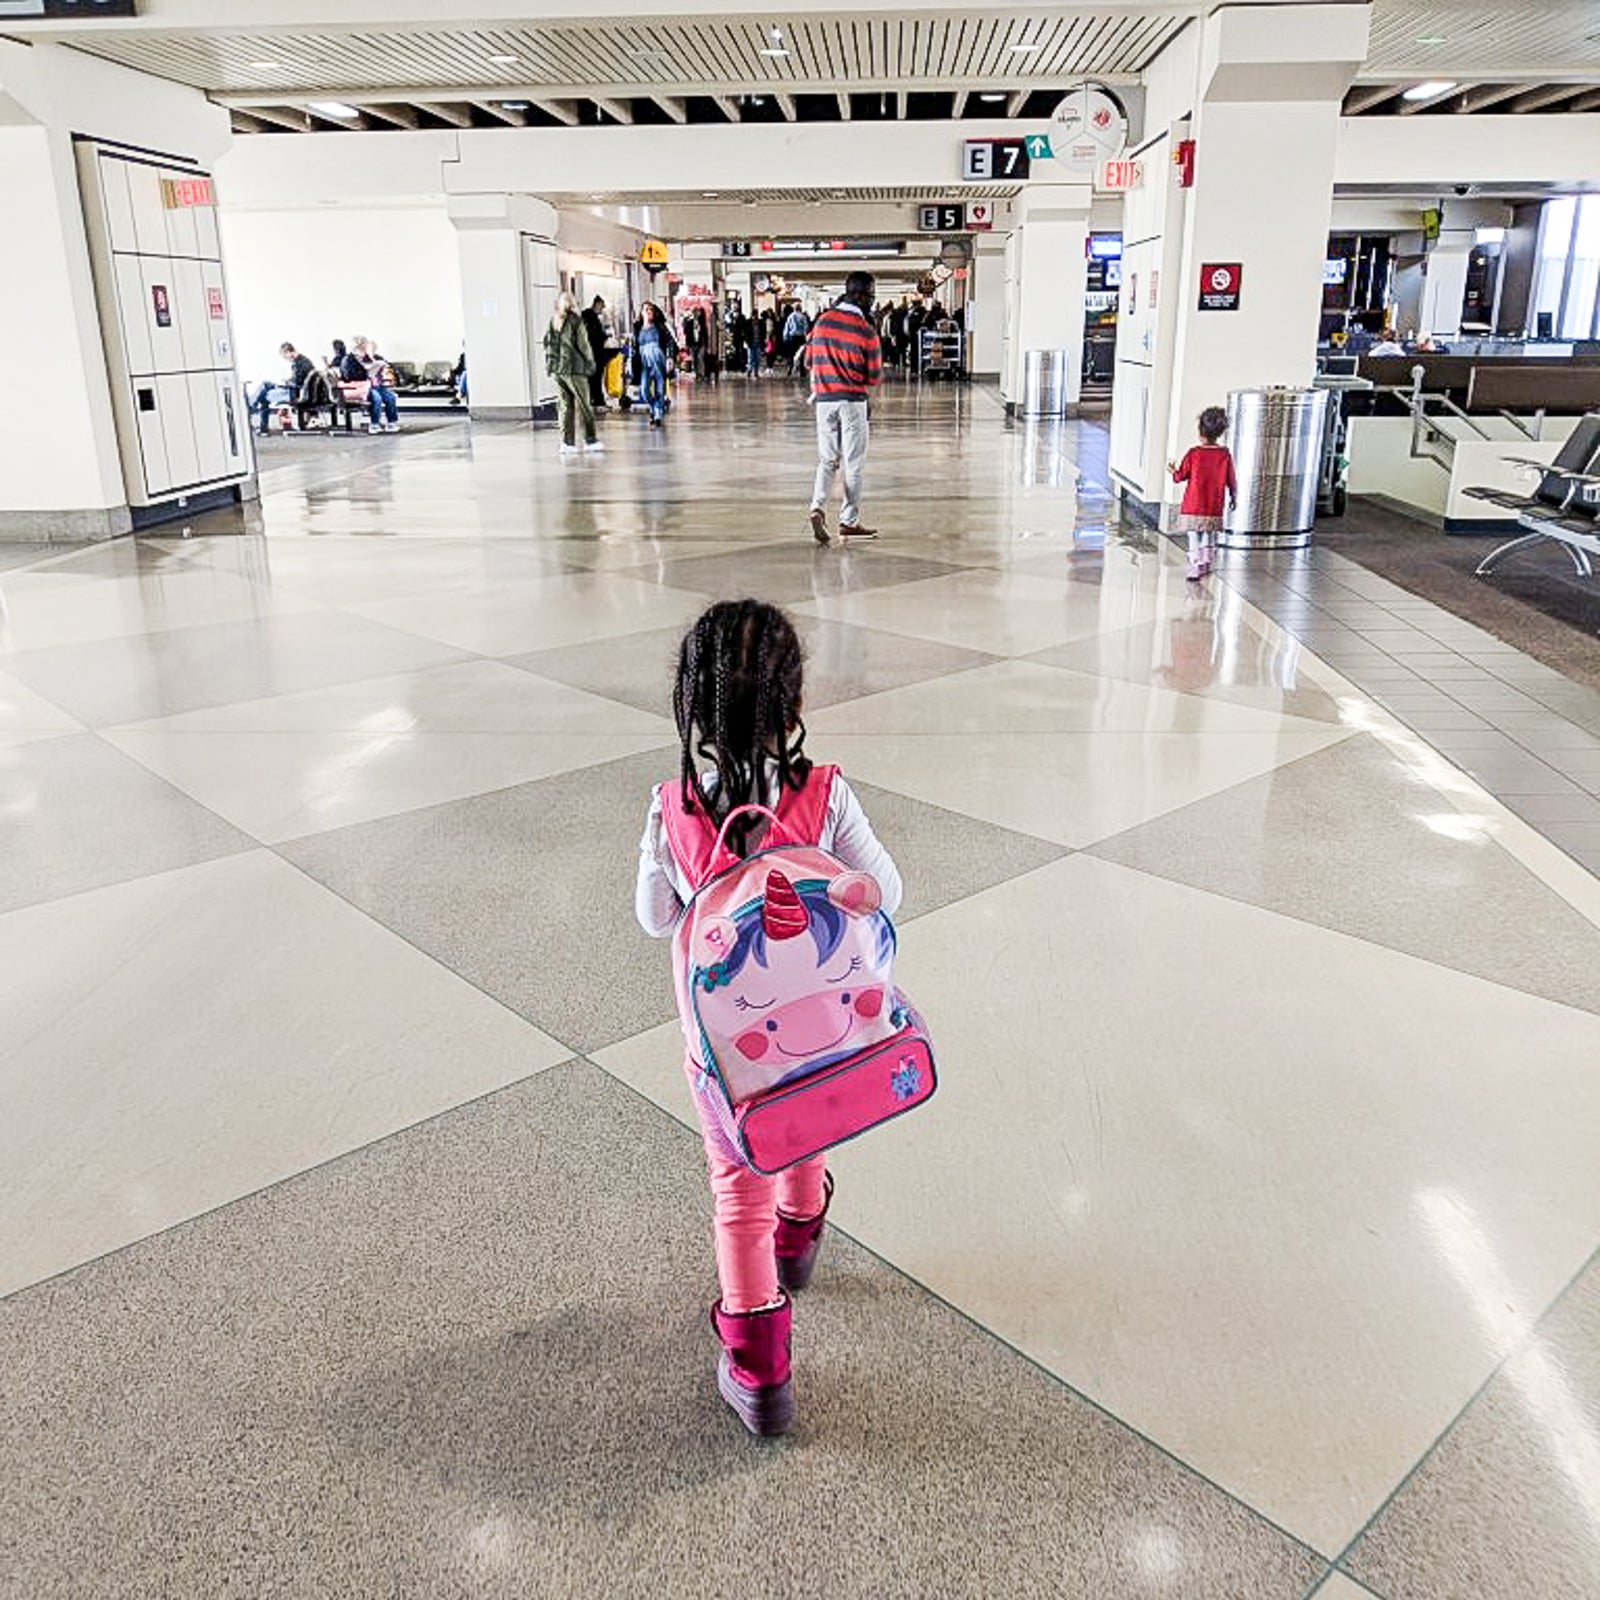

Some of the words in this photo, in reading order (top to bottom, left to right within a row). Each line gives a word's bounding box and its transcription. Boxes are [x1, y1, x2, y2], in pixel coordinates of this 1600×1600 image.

[970, 149, 985, 174] E
[1003, 147, 1019, 174] 7
[1105, 162, 1136, 188] EXIT
[180, 180, 211, 206] EXIT
[923, 211, 935, 227] E
[944, 211, 955, 227] 5
